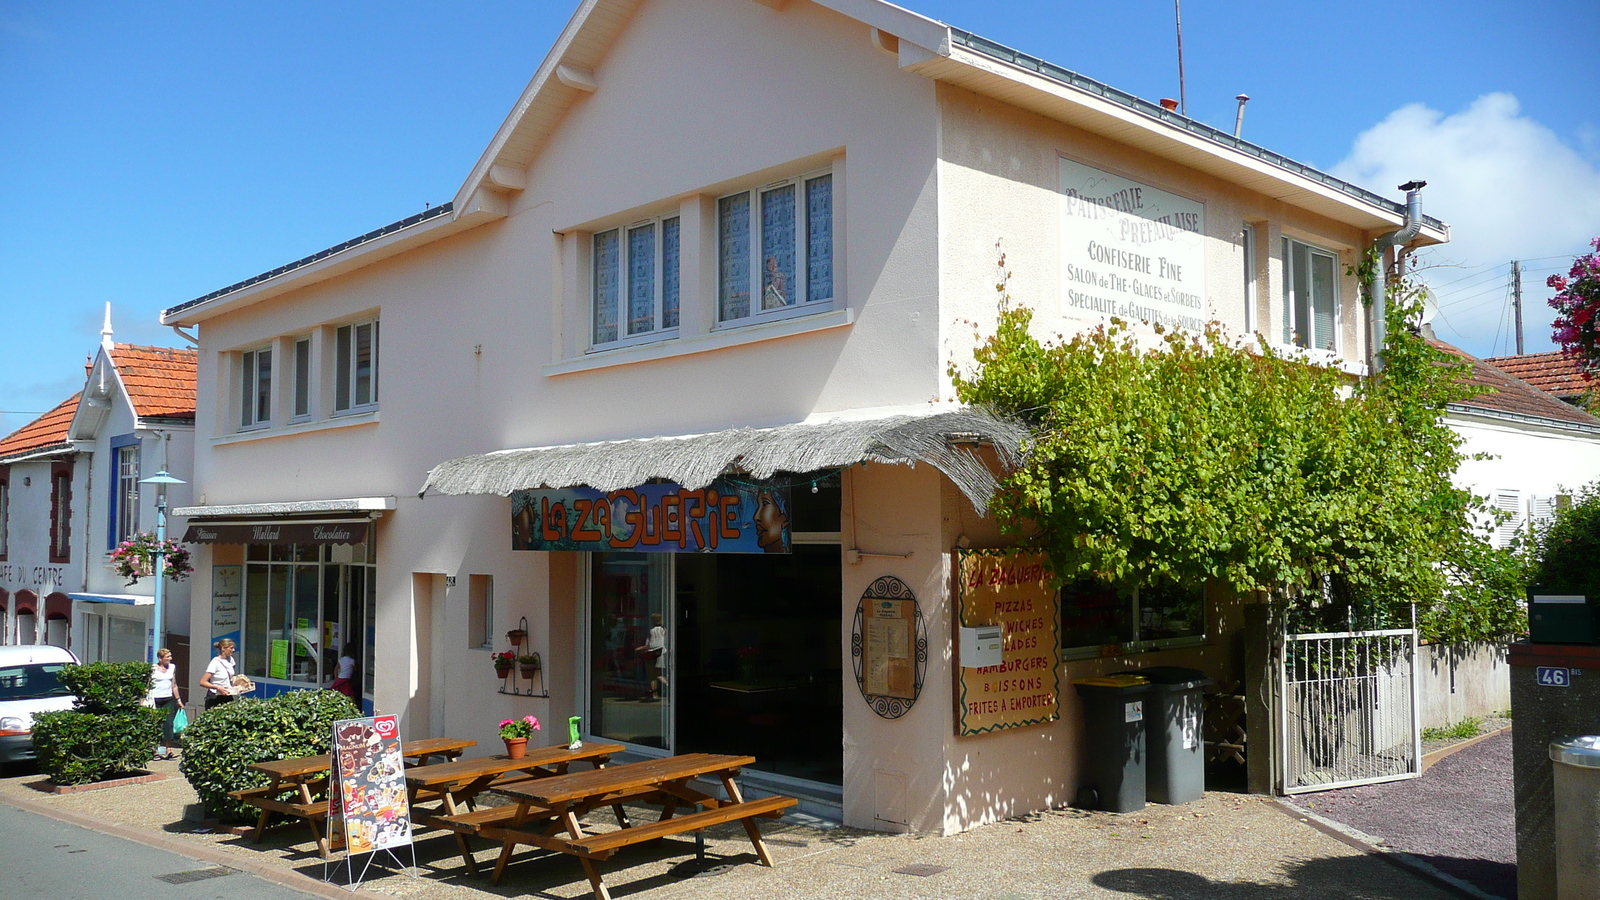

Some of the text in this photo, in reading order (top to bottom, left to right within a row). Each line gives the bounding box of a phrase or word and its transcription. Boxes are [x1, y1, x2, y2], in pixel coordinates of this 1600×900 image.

[1065, 187, 1144, 220] PATISSERIE
[1087, 240, 1182, 282] CONFISERIE FINE
[1068, 263, 1202, 310] SALON de THE GLACES et SORBETS
[1068, 289, 1117, 315] SPECIALITE
[1118, 304, 1128, 317] de
[1128, 301, 1163, 325] GALETTES
[1177, 314, 1202, 333] SOURCE
[542, 496, 567, 541] LA
[33, 566, 63, 587] CENTRE
[968, 569, 984, 588] LA
[994, 599, 1033, 615] PIZZAS
[984, 677, 1042, 693] BOISSONS
[1542, 669, 1563, 684] 46
[968, 701, 998, 715] FRITES
[1010, 693, 1053, 711] EMPORTER
